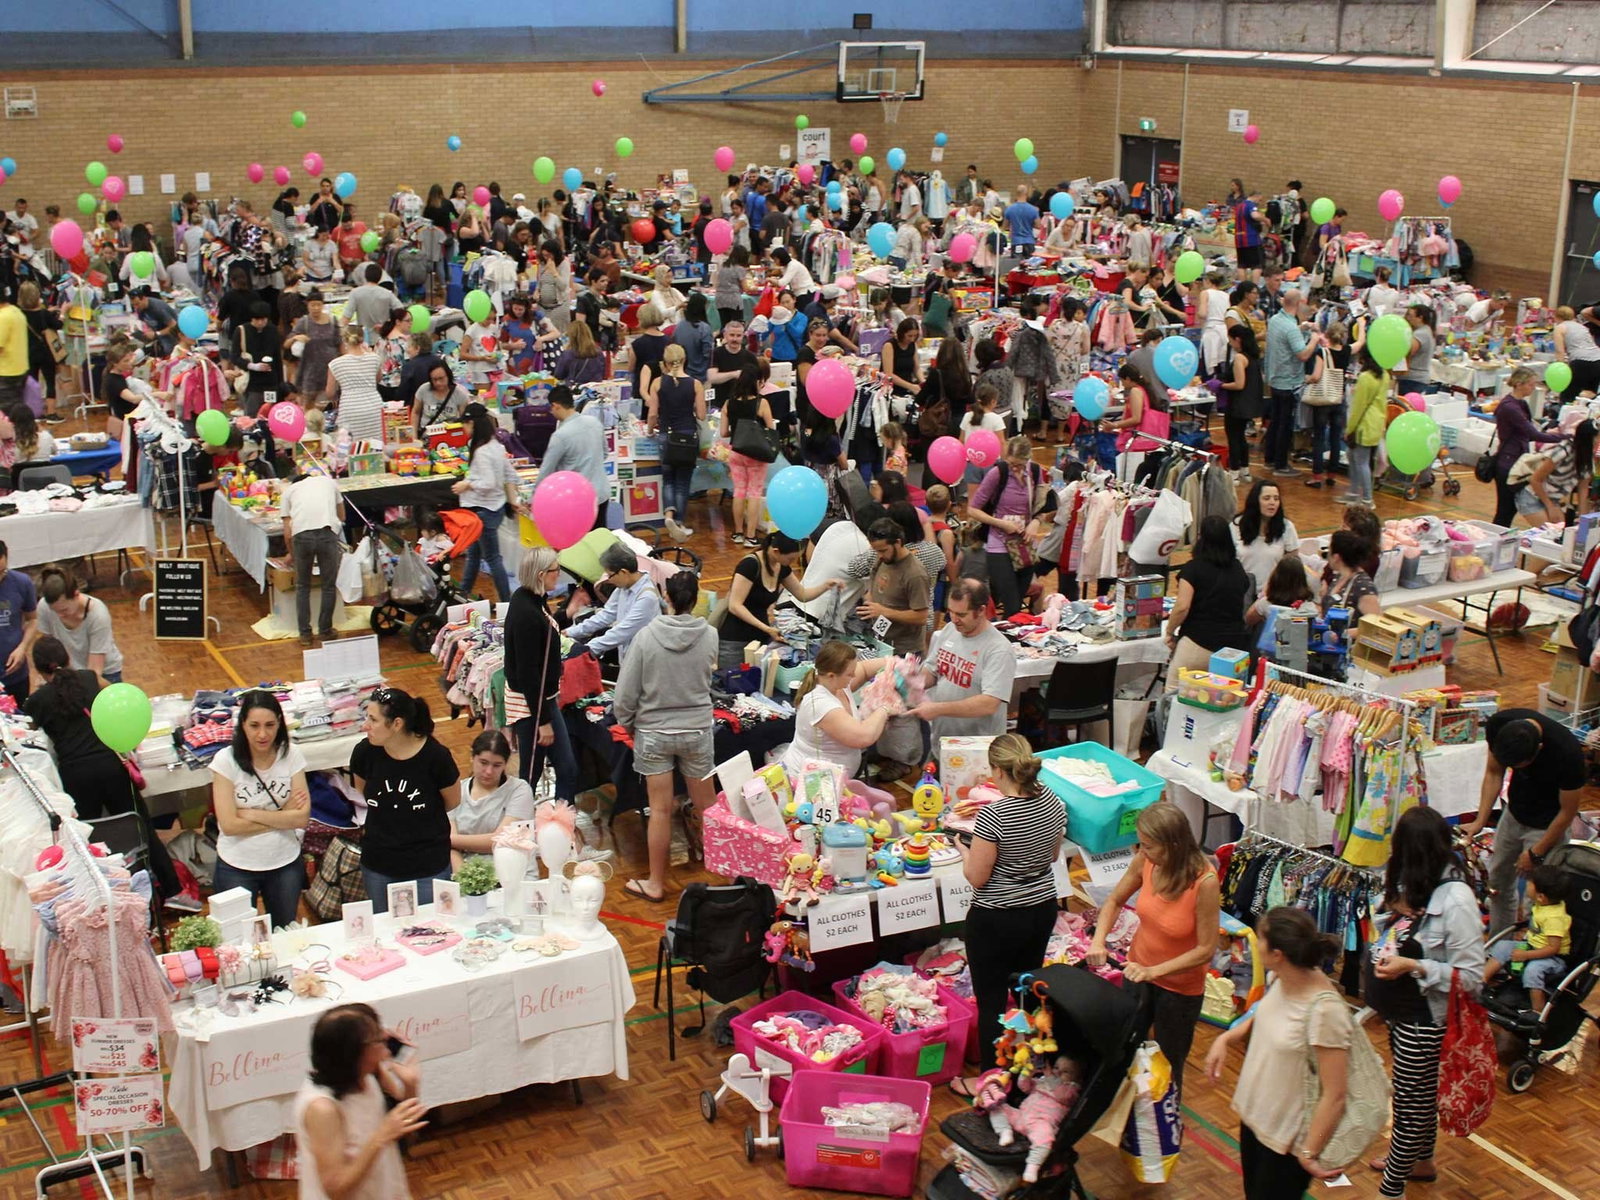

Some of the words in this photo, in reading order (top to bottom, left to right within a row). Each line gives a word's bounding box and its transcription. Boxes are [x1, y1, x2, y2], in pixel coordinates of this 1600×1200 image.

[802, 132, 826, 142] court
[957, 656, 976, 674] THE
[367, 780, 426, 810] D-LUXE
[816, 808, 832, 822] 45
[1103, 849, 1132, 860] CLOTHES
[1102, 866, 1112, 874] $2
[950, 887, 961, 895] ALL
[901, 893, 933, 906] CLOTHES
[959, 900, 968, 908] $2
[817, 917, 830, 925] ALL
[832, 909, 866, 922] CLOTHES
[906, 908, 927, 918] EACH
[826, 929, 836, 938] $2
[838, 924, 858, 934] EACH
[520, 984, 590, 1018] Bellina
[208, 1050, 288, 1087] Bellina
[90, 1108, 127, 1117] 50-70%
[129, 1104, 149, 1113] OFF
